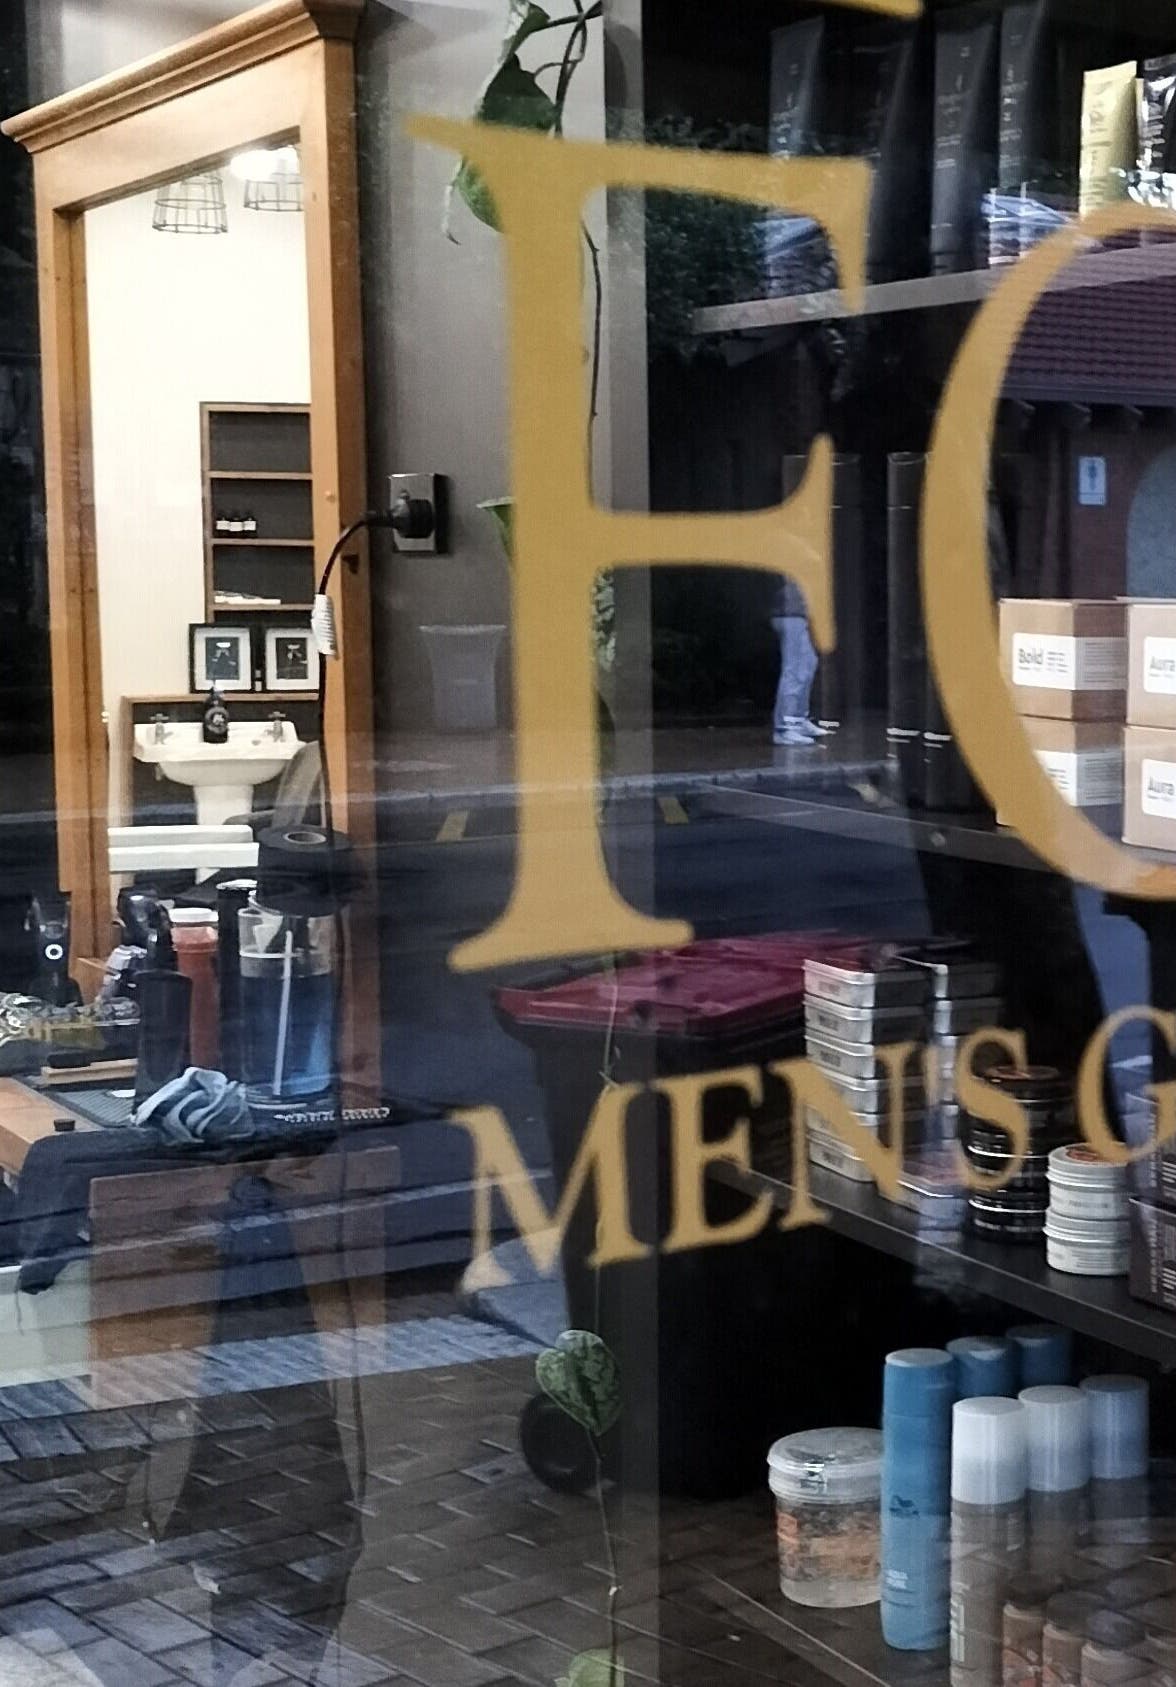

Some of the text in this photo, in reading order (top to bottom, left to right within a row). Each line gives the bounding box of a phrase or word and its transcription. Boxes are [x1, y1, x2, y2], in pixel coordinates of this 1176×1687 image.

[1017, 648, 1043, 665] Bold
[1149, 657, 1176, 673] Aura
[1147, 775, 1175, 796] Aura
[449, 1026, 1031, 1293] MEN'S
